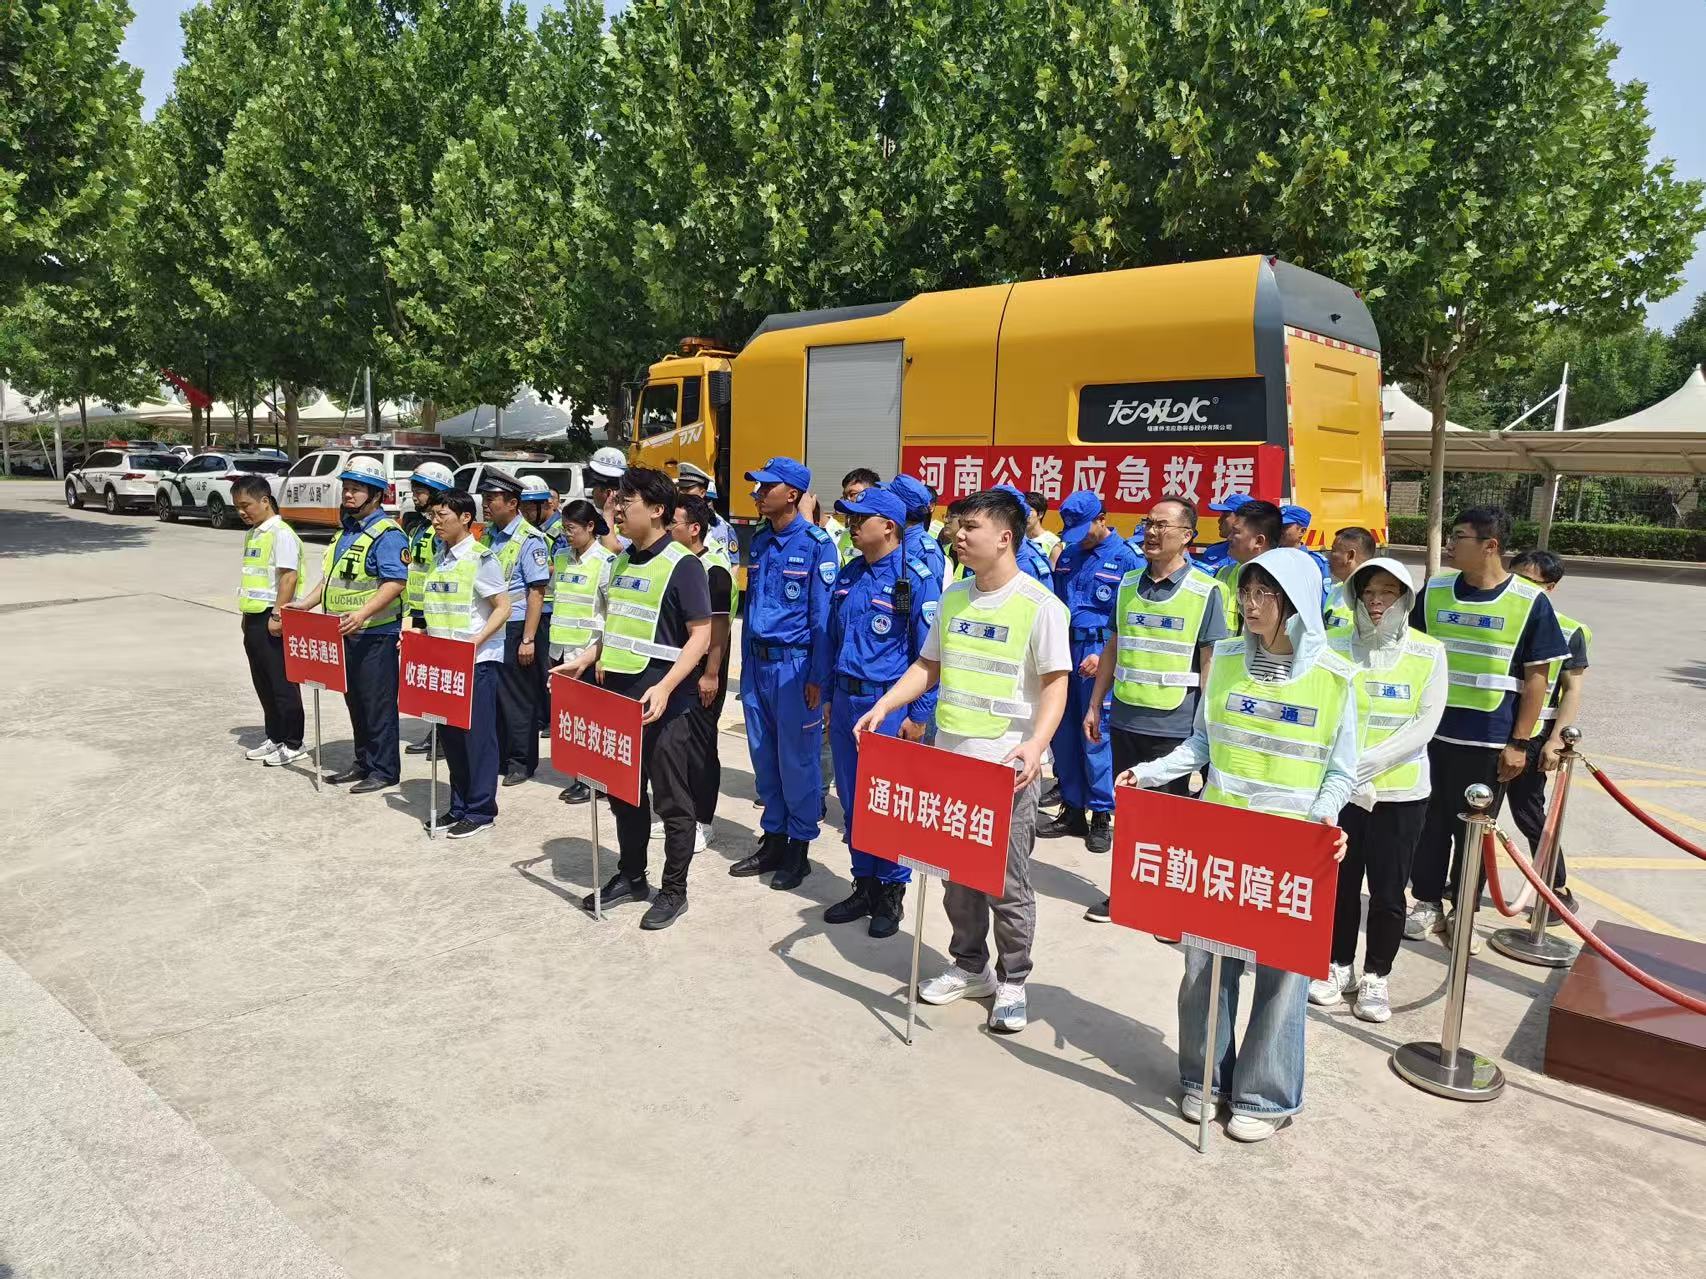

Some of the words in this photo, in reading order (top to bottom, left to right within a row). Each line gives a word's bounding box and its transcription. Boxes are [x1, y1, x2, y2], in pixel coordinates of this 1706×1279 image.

[918, 455, 1255, 505] 河南公路应急救援
[957, 622, 996, 639] 交通
[1135, 614, 1173, 629] 交通
[1448, 612, 1492, 628] 交通
[288, 635, 340, 666] 安全保通组
[405, 661, 466, 697] 收费管理组
[1240, 699, 1300, 723] 交通
[558, 709, 633, 767] 抢险救援组
[867, 776, 996, 848] 通讯联络组
[1130, 841, 1314, 922] 后勤保障组
